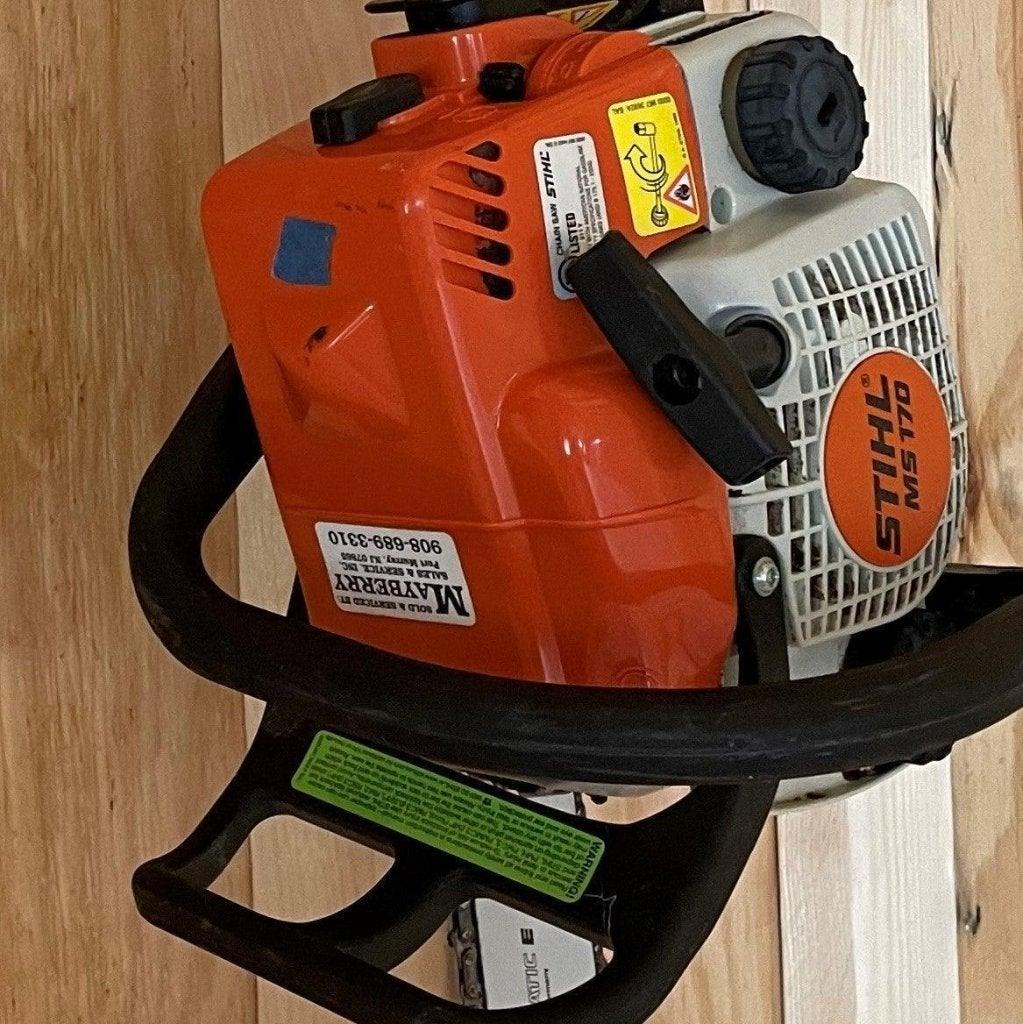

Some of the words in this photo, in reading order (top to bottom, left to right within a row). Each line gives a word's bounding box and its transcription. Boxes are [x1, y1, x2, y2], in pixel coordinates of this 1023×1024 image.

[539, 150, 556, 199] STIHL
[549, 203, 558, 224] SAW
[552, 226, 563, 255] CHAIN
[564, 211, 580, 253] LISTED
[894, 380, 915, 442] 170
[864, 374, 901, 556] STIHL
[900, 450, 920, 511] MS
[326, 530, 443, 555] 908-689-3310
[369, 555, 381, 563] NJ
[419, 559, 439, 569] Port
[415, 569, 448, 580] SALES
[334, 572, 469, 617] MAYBERRY
[407, 603, 432, 613] SOLD
[564, 840, 603, 900] WARNING!
[520, 928, 535, 945] E
